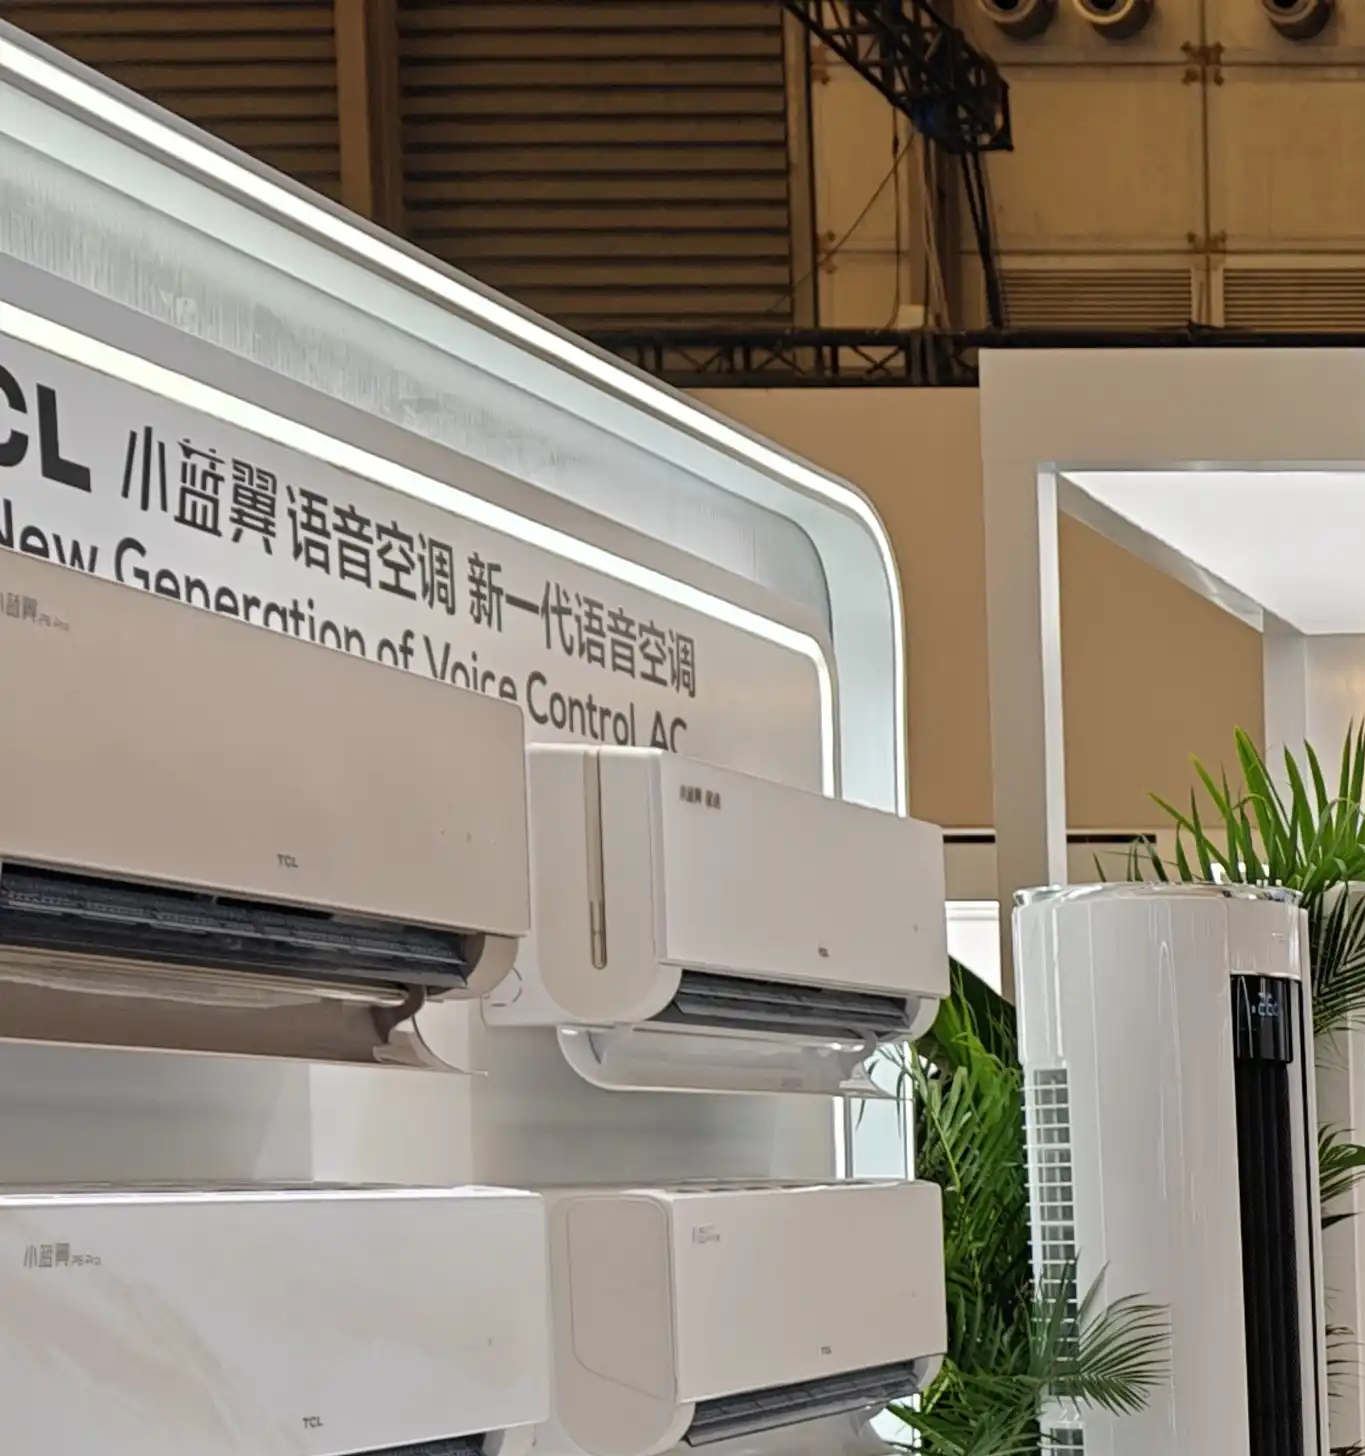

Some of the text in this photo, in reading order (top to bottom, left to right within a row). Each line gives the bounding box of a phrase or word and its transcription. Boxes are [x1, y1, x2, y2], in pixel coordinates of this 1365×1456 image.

[121, 426, 456, 616] 小蓝翼语音空调
[468, 552, 697, 699] 新一代语音空调
[526, 671, 636, 747] Control
[277, 853, 299, 868] TCL
[302, 1416, 324, 1429] TCL
